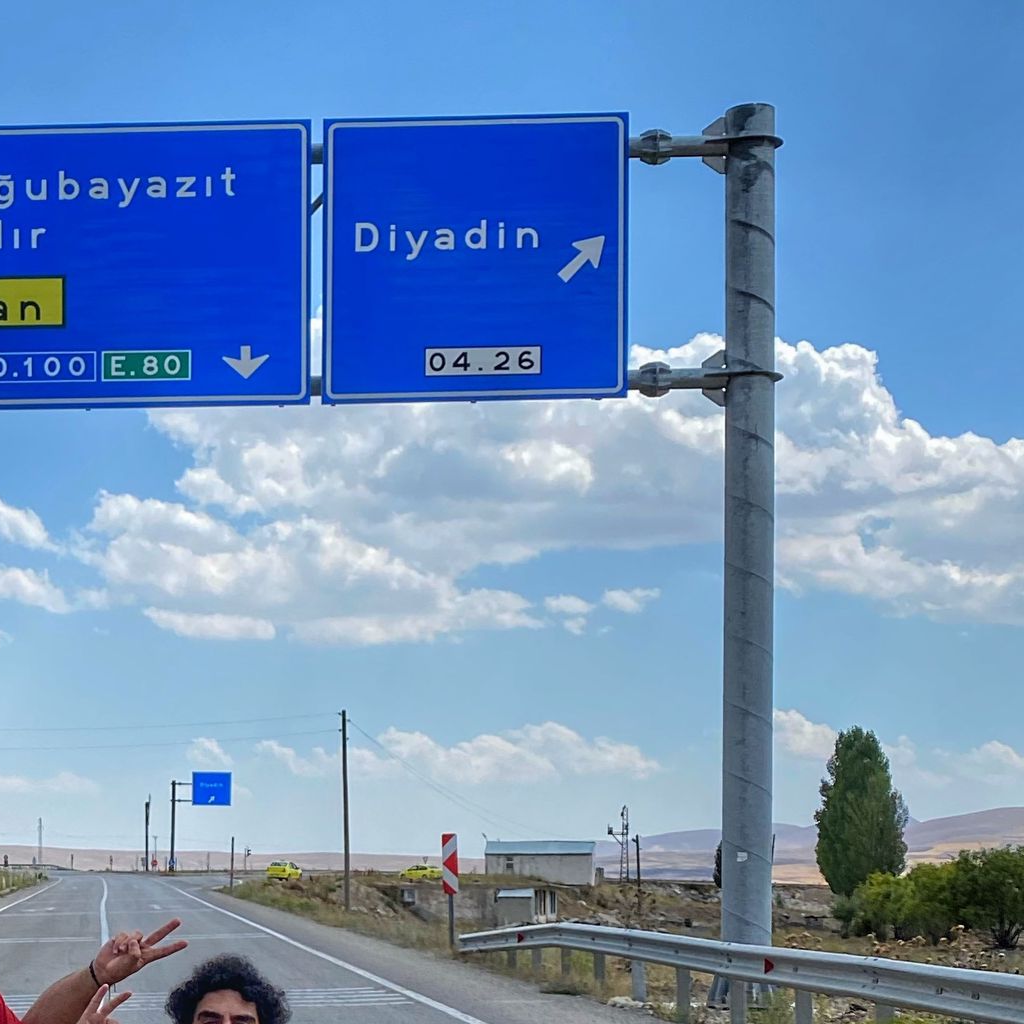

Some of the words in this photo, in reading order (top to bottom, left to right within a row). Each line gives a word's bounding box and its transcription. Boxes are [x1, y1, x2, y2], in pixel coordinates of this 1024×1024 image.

[354, 219, 539, 261] Diyadin
[110, 355, 181, 376] E.80
[429, 350, 535, 372] 04.26
